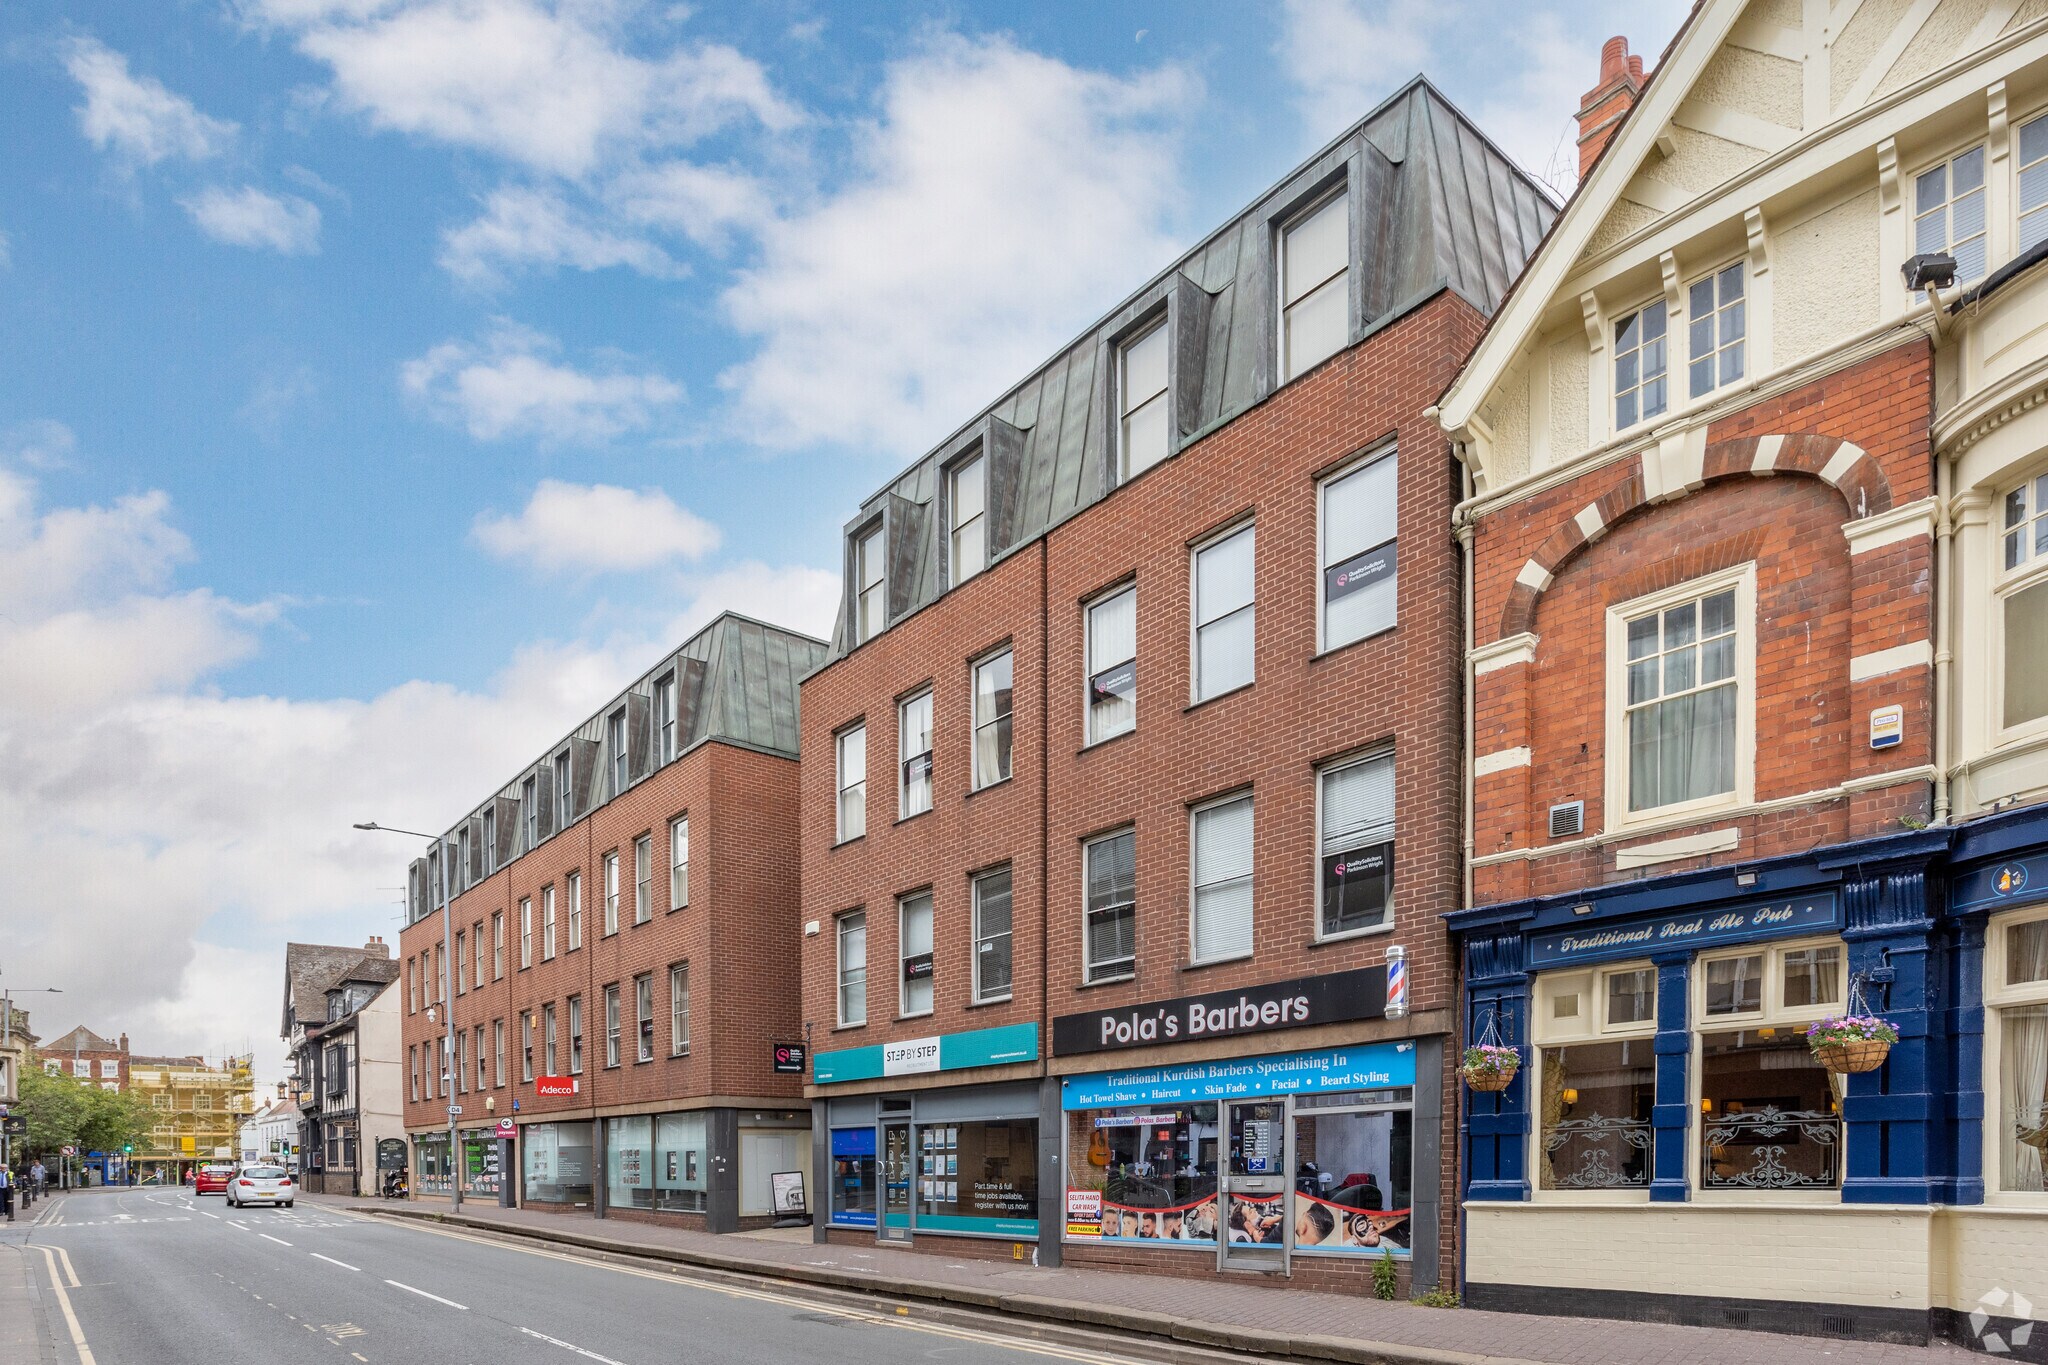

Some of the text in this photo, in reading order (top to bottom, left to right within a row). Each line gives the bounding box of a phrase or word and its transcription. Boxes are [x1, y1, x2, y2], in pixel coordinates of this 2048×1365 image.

[1346, 855, 1382, 868] QualitySolicitors
[1561, 904, 1794, 952] Traditional Real Ale Pub
[1101, 996, 1310, 1045] Pola's Barbers
[886, 1045, 937, 1062] STEP BY STEP
[1106, 1053, 1347, 1087] Traditional Kurdish Barbers Specialising In
[540, 1085, 572, 1094] Adecco
[1079, 1071, 1390, 1104] Hot Towel Shave Haircut Skin Fade Facial Beard Styling
[1004, 1182, 1013, 1190] full
[999, 1193, 1024, 1201] available,
[974, 1202, 995, 1210] register
